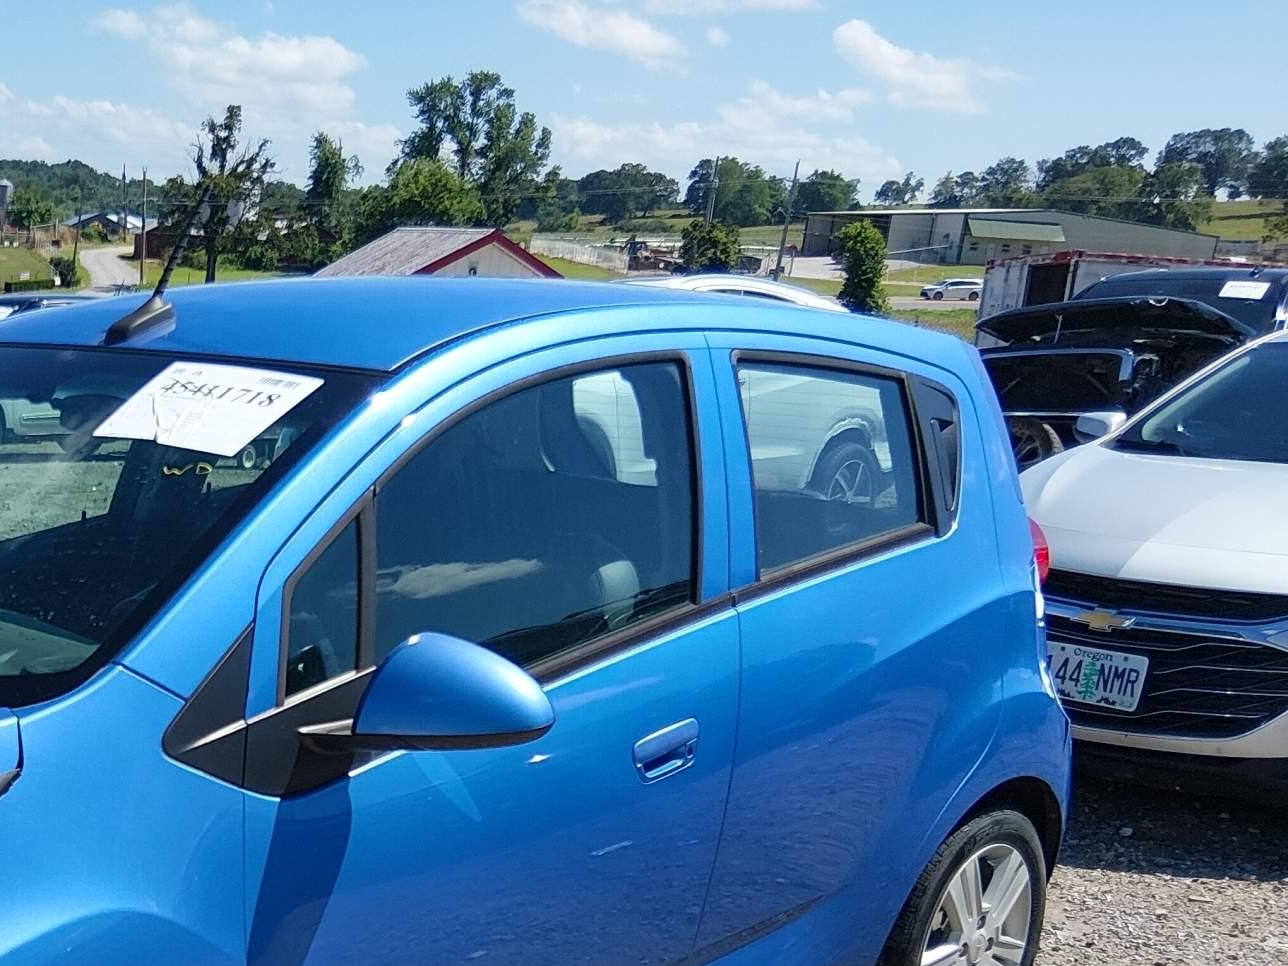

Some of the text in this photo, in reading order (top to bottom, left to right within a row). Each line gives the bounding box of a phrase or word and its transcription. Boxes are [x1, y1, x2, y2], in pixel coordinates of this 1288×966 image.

[161, 377, 281, 407] 45411718
[1073, 647, 1113, 662] Oregon
[1095, 663, 1140, 698] NMR
